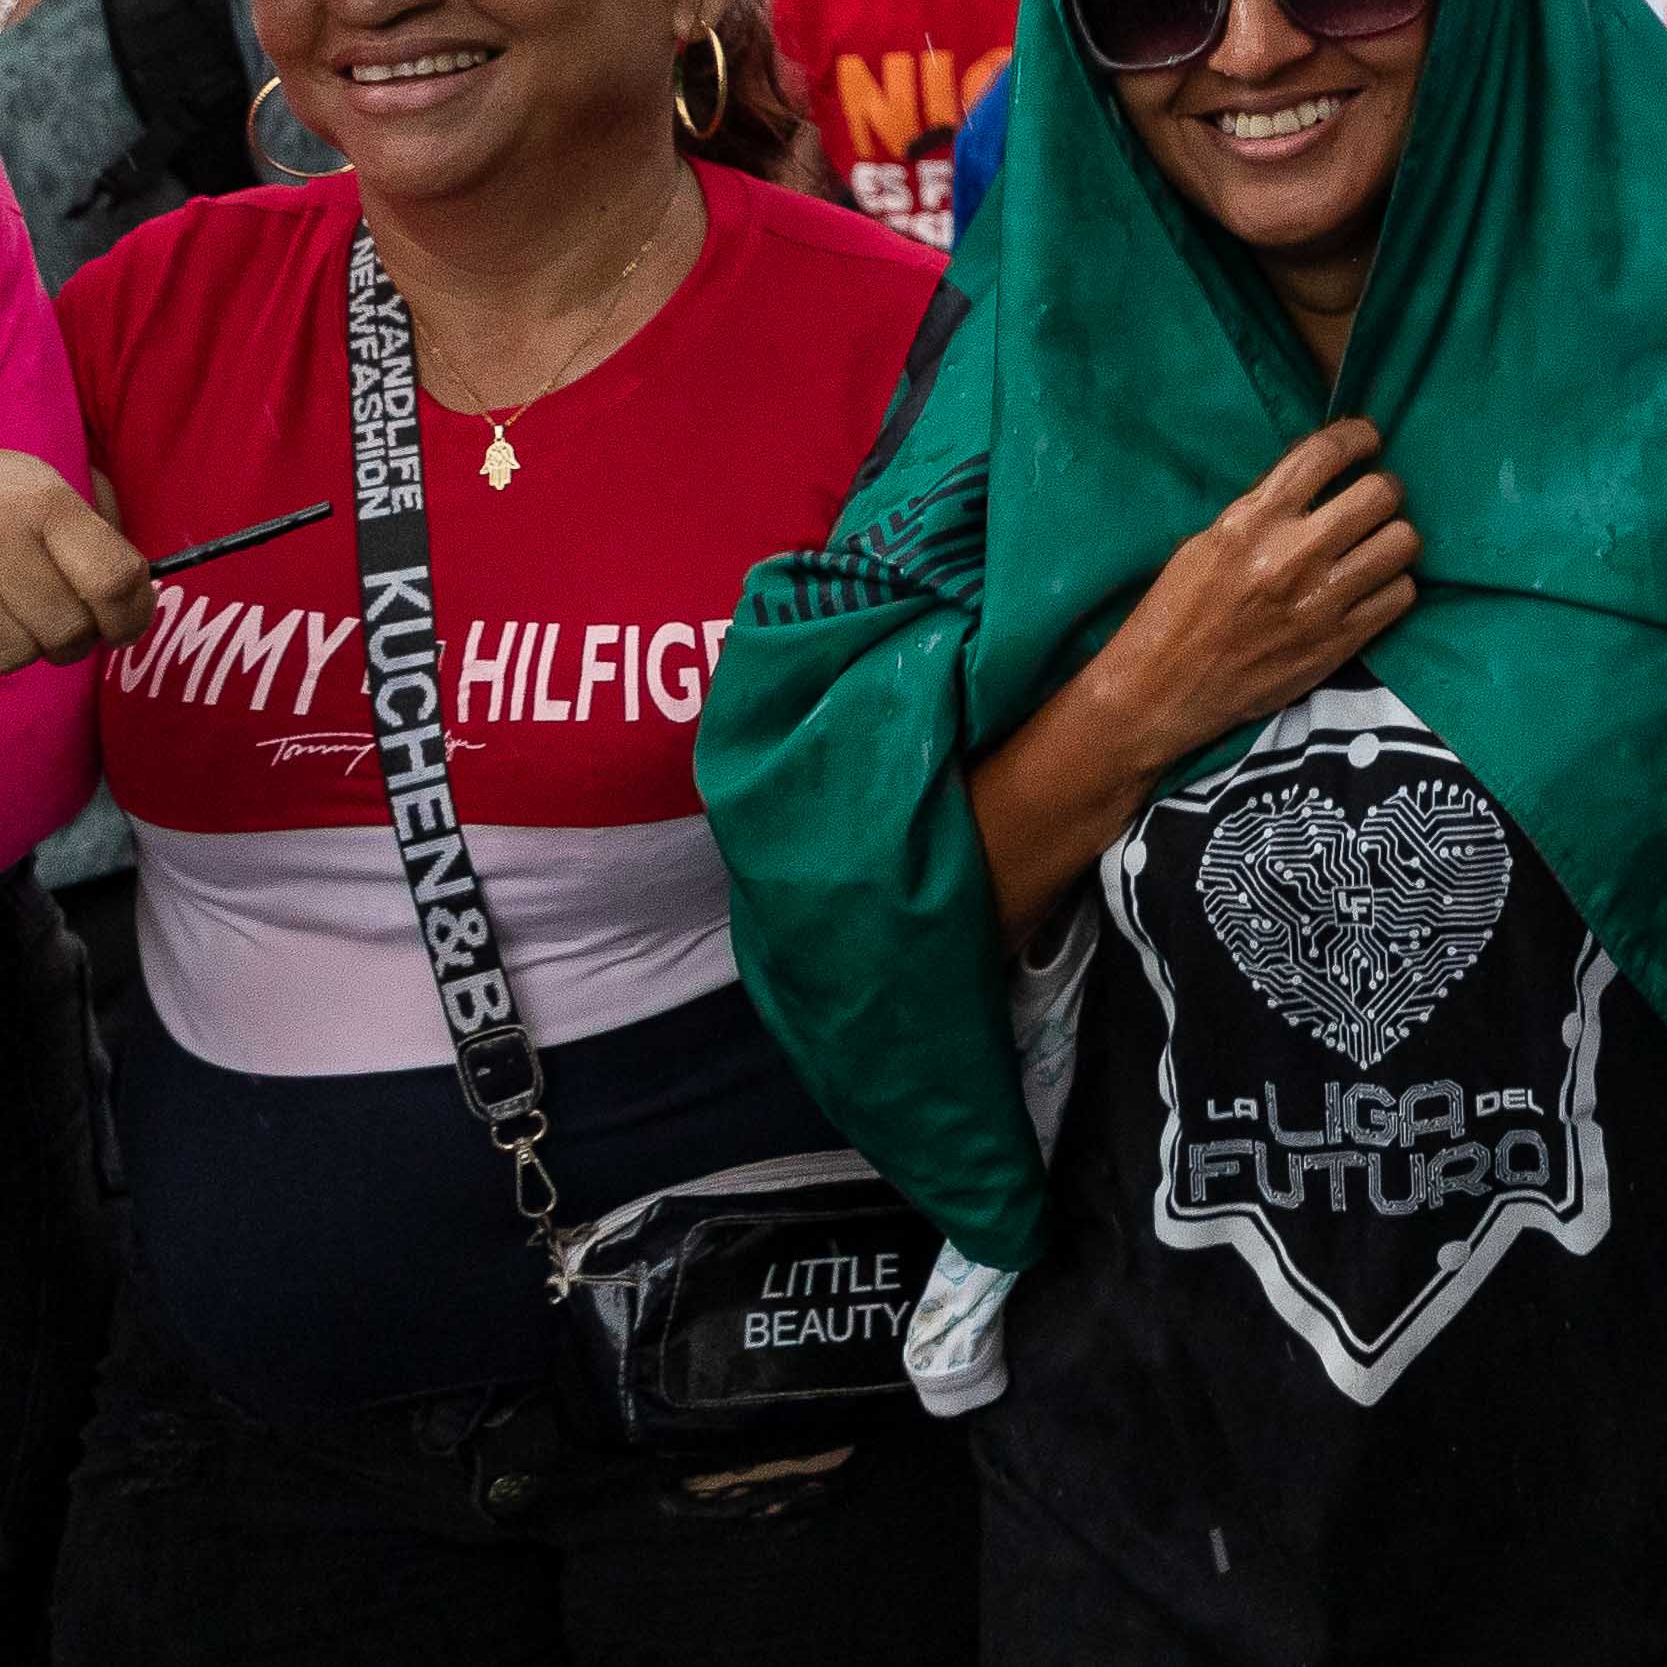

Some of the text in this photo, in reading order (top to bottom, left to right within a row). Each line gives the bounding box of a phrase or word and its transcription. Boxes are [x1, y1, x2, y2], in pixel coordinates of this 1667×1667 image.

[371, 272, 423, 512] YANDLIFE
[105, 580, 361, 717] OMMY
[1206, 1078, 1544, 1149] LA LIGA DEL
[1188, 1128, 1550, 1215] FUTURO
[760, 1252, 903, 1301] LITTLE
[743, 1301, 910, 1350] BEAUTY
